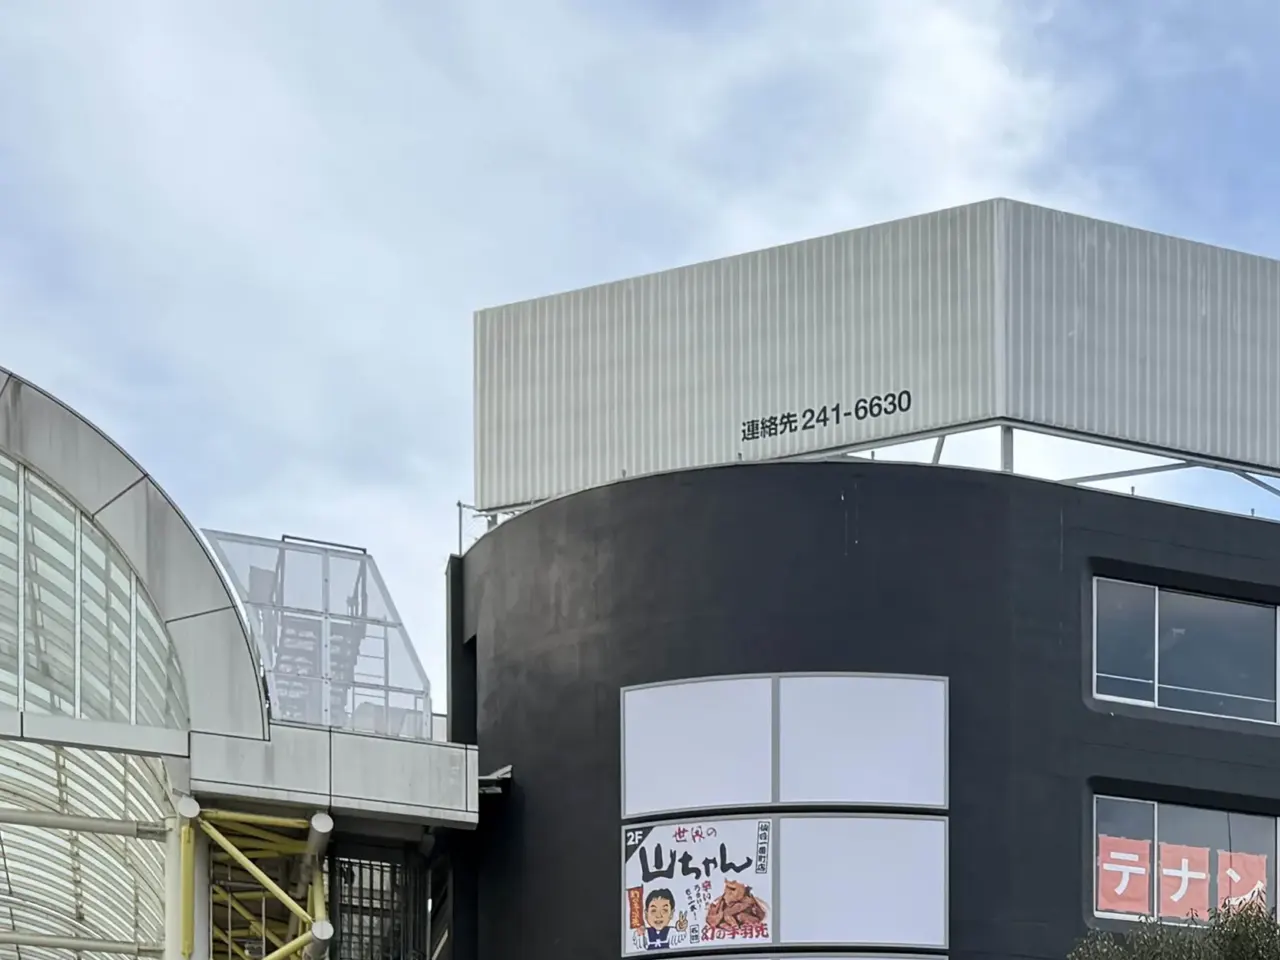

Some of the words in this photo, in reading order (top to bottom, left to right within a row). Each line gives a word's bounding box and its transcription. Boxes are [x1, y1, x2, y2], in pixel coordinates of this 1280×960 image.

[741, 412, 798, 442] 連絡先
[801, 389, 912, 431] 241-6630
[626, 831, 643, 846] 2F
[673, 826, 717, 843] 世界の
[639, 843, 753, 882] 山ちゃん
